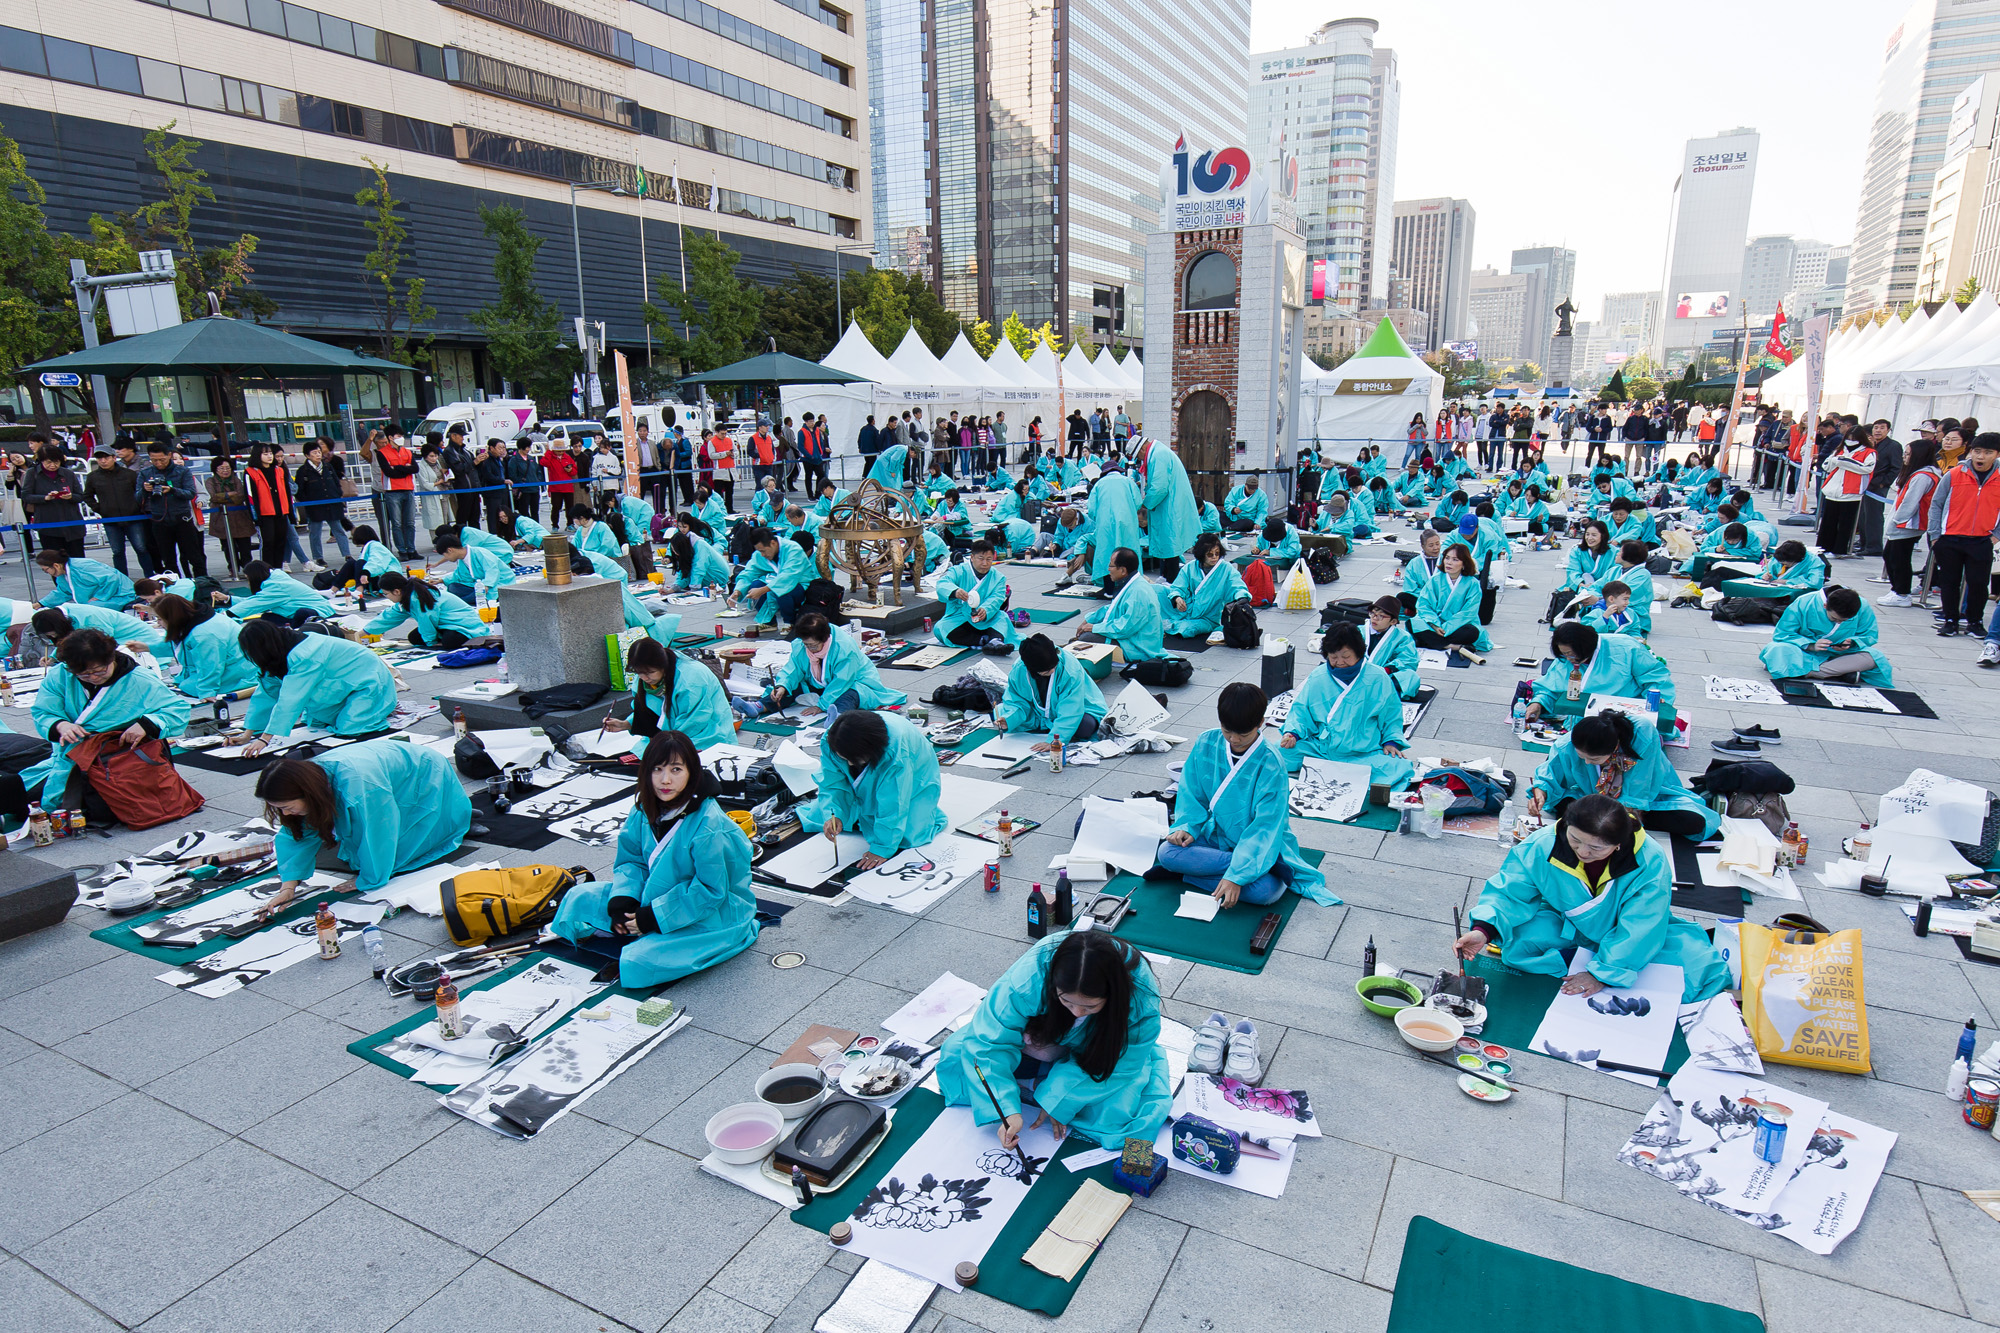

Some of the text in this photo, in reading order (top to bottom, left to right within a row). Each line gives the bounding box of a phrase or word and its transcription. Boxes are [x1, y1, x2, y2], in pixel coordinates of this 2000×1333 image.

[1261, 56, 1306, 72] 동아일보
[1692, 151, 1748, 167] 조선일보
[1692, 163, 1746, 174] chosun.com
[1175, 197, 1246, 215] 국민이 지킨 역사
[1175, 211, 1245, 229] 국민이 이끌 나라
[1353, 382, 1393, 392] 종합안내소
[1825, 955, 1853, 965] AND
[1818, 965, 1853, 977] LOVE
[1812, 976, 1854, 988] CLEAN
[1809, 987, 1856, 1000] WATER.
[1812, 999, 1856, 1011] PLEASE
[1828, 1009, 1857, 1021] SAVE
[1812, 1018, 1859, 1032] WATER!
[1801, 1027, 1860, 1050] SAVE
[1794, 1045, 1860, 1062] OUR LIFE!
